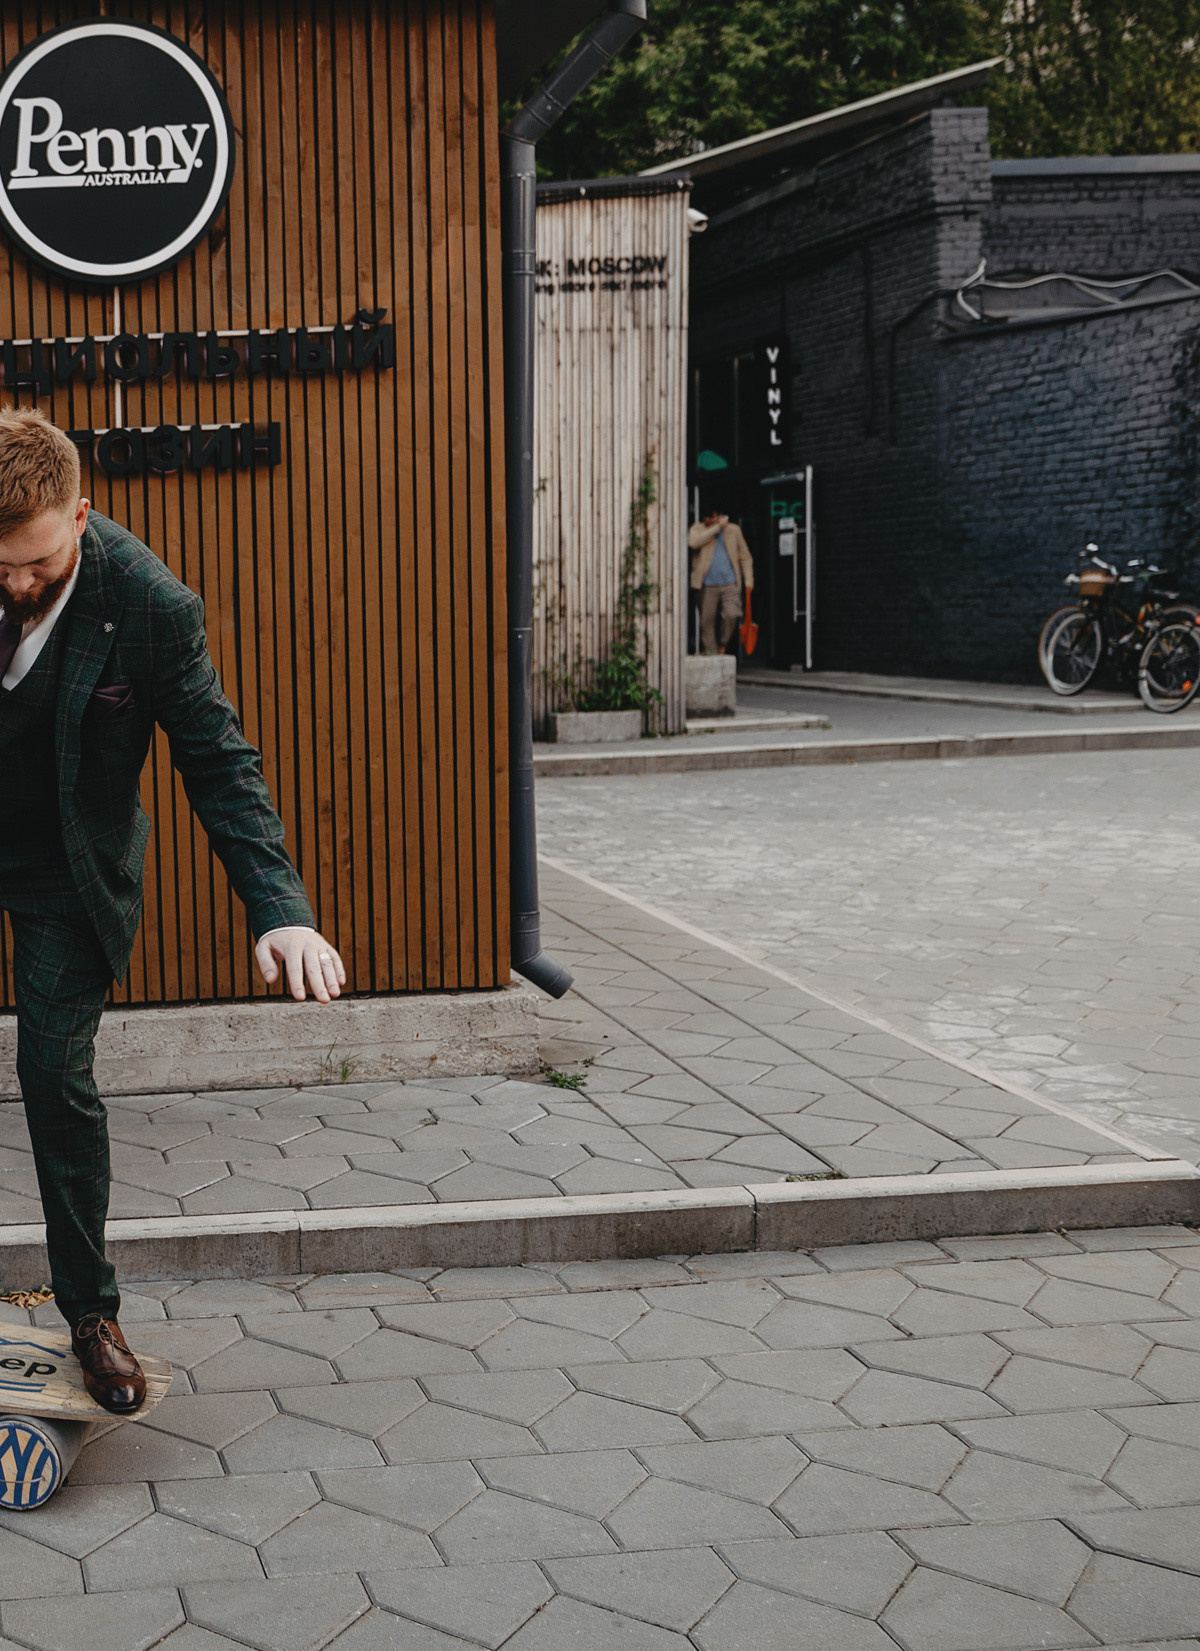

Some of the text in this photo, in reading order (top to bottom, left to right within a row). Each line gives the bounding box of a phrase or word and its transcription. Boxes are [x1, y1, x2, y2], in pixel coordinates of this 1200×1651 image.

[84, 171, 166, 187] AUSTRALIA
[566, 255, 668, 277] MOSCOW
[766, 346, 782, 446] VINYL
